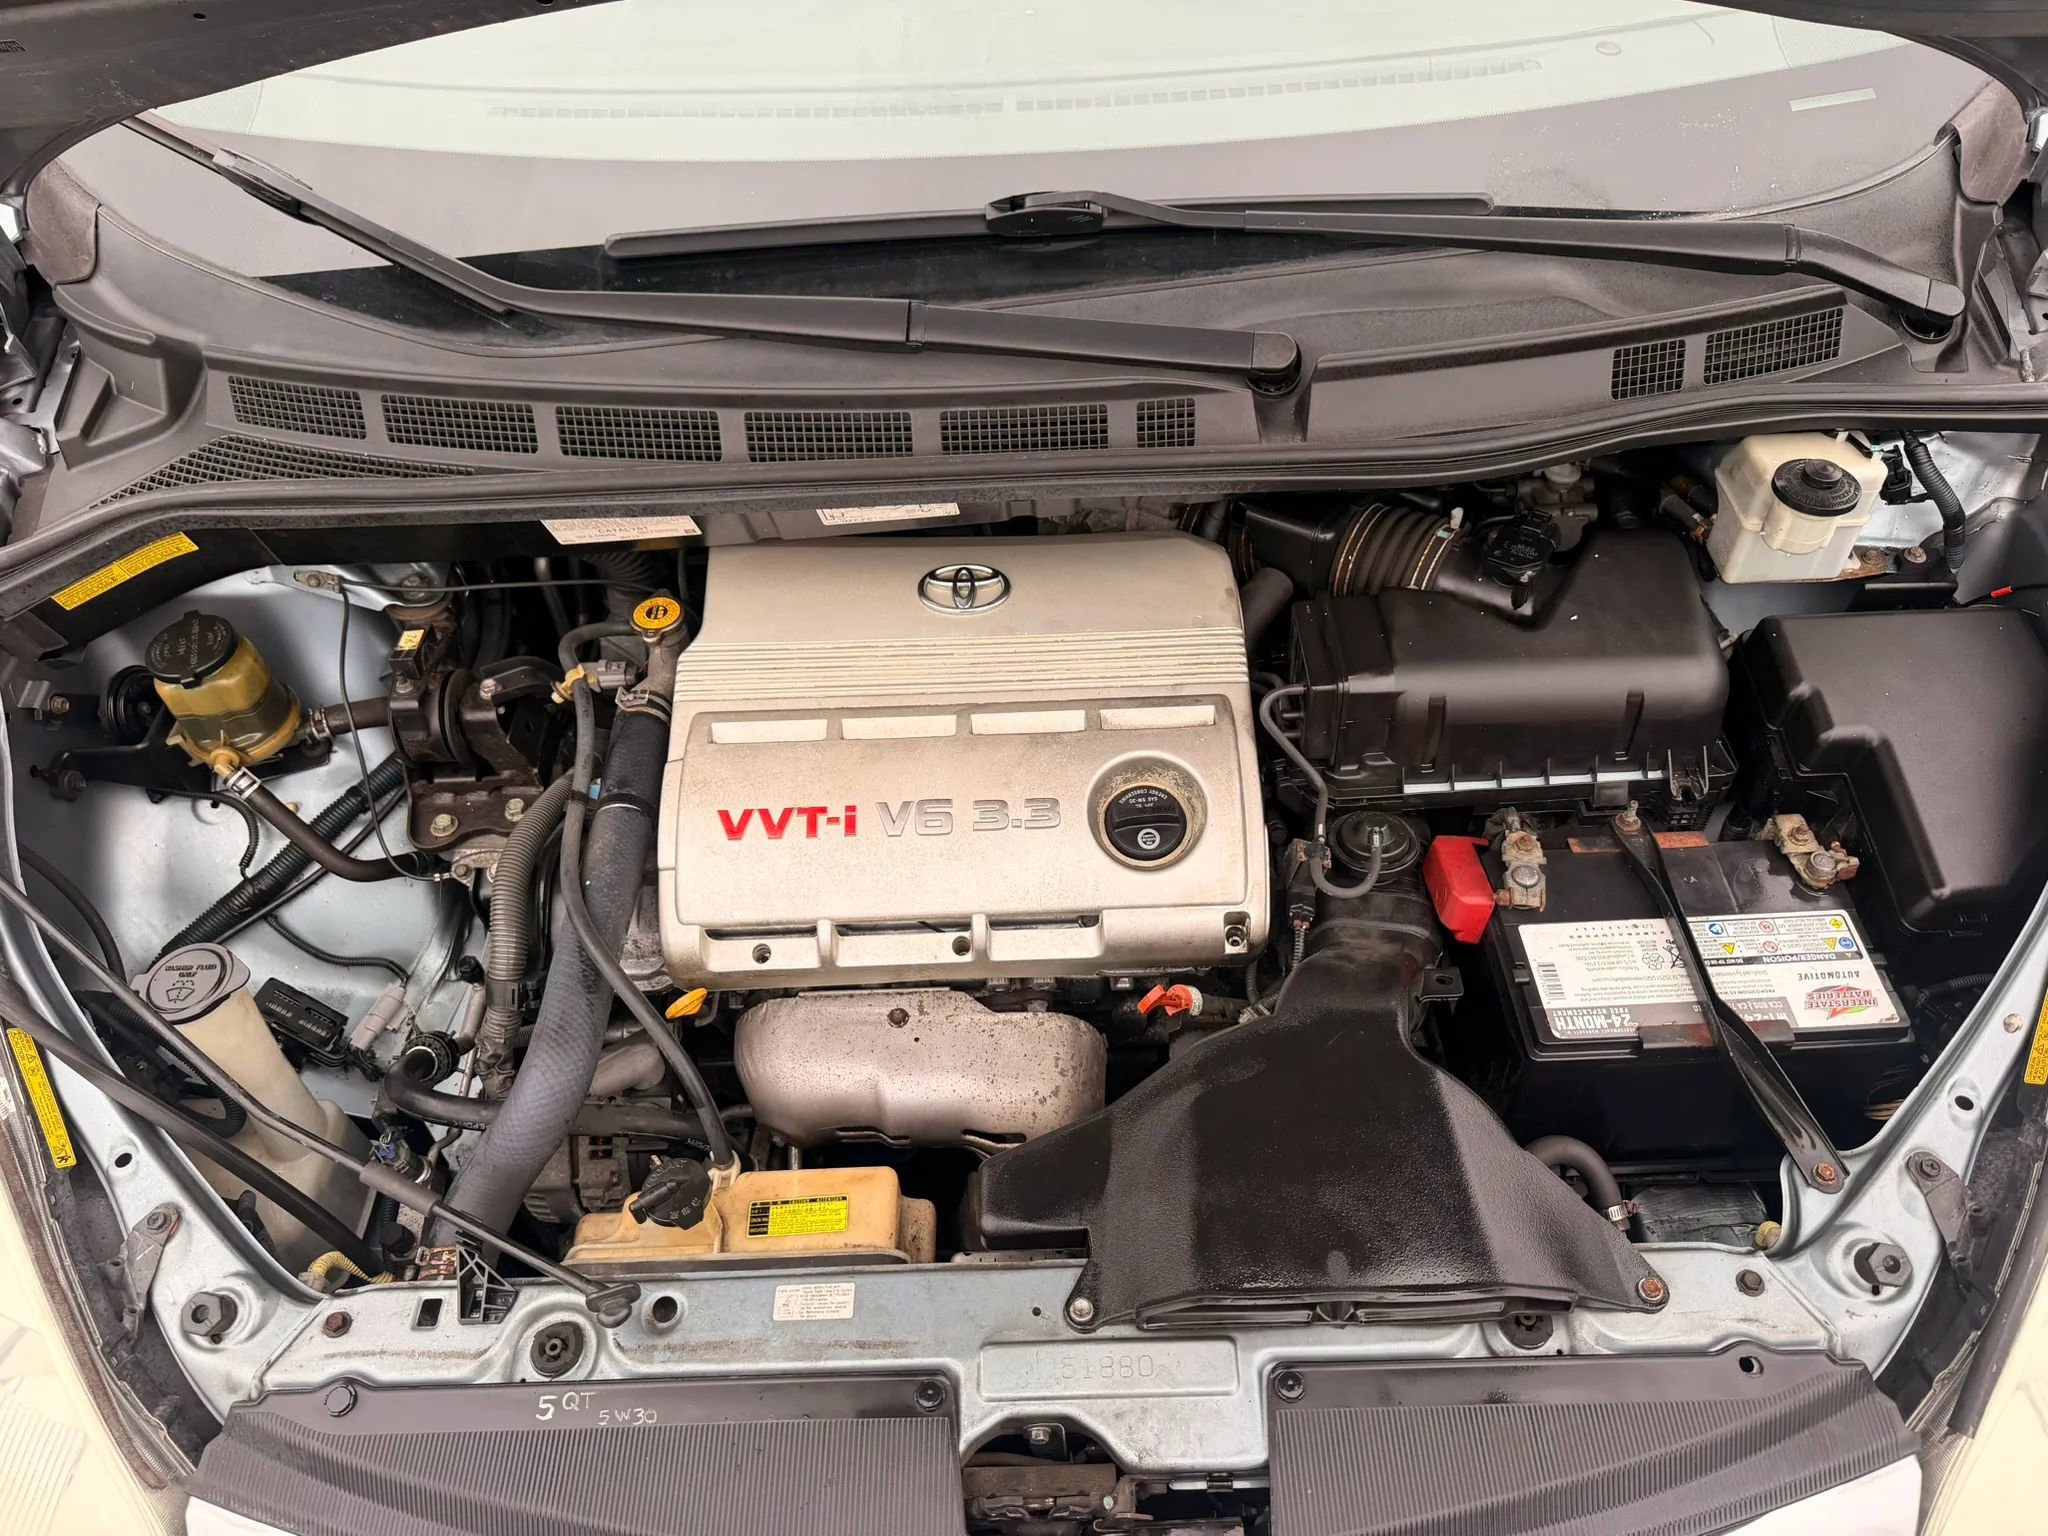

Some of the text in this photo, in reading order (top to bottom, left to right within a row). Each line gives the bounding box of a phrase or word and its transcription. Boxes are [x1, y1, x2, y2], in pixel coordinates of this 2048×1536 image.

[1119, 789, 1168, 804] ENERGY CONSERVING
[717, 797, 1062, 840] VVT-i V6 3.3
[1763, 953, 1836, 963] DANGER/POISON
[1798, 971, 1860, 981] AUTOMOTIVE
[1807, 990, 1871, 999] BATTERIES
[1737, 1002, 1747, 1010] CA
[1768, 1000, 1783, 1008] CCA
[1807, 998, 1877, 1009] INTERSTATE
[1553, 1008, 1608, 1017] REPLACEMENT
[1554, 1013, 1632, 1031] 24-MONTH
[1061, 1354, 1154, 1379] 51880
